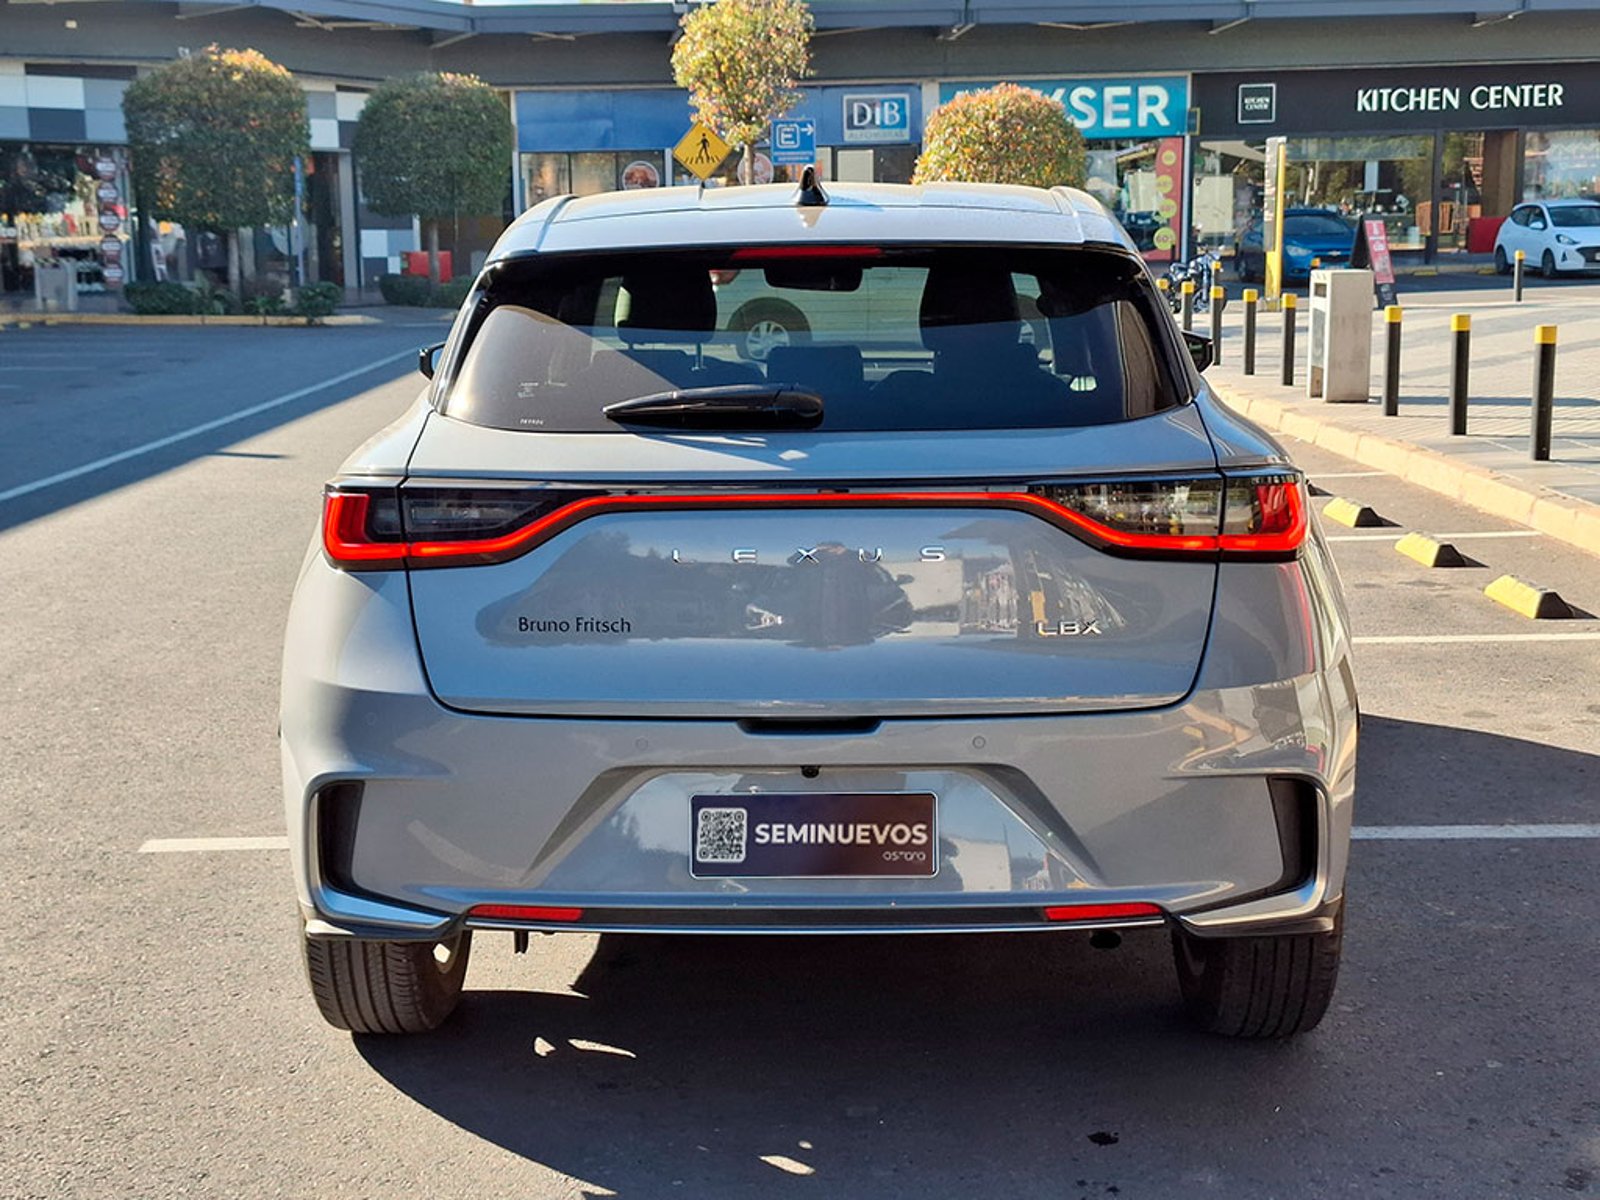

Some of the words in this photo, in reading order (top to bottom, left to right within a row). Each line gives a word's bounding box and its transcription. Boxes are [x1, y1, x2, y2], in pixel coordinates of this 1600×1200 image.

[1357, 87, 1460, 112] KITCHEN
[1470, 84, 1564, 109] CENTER
[780, 126, 795, 145] E
[671, 547, 946, 564] LEXUS
[518, 616, 570, 632] Bruno
[576, 616, 631, 633] Fritsch
[1036, 620, 1102, 636] LBX
[754, 823, 928, 845] SEMINUEVOS
